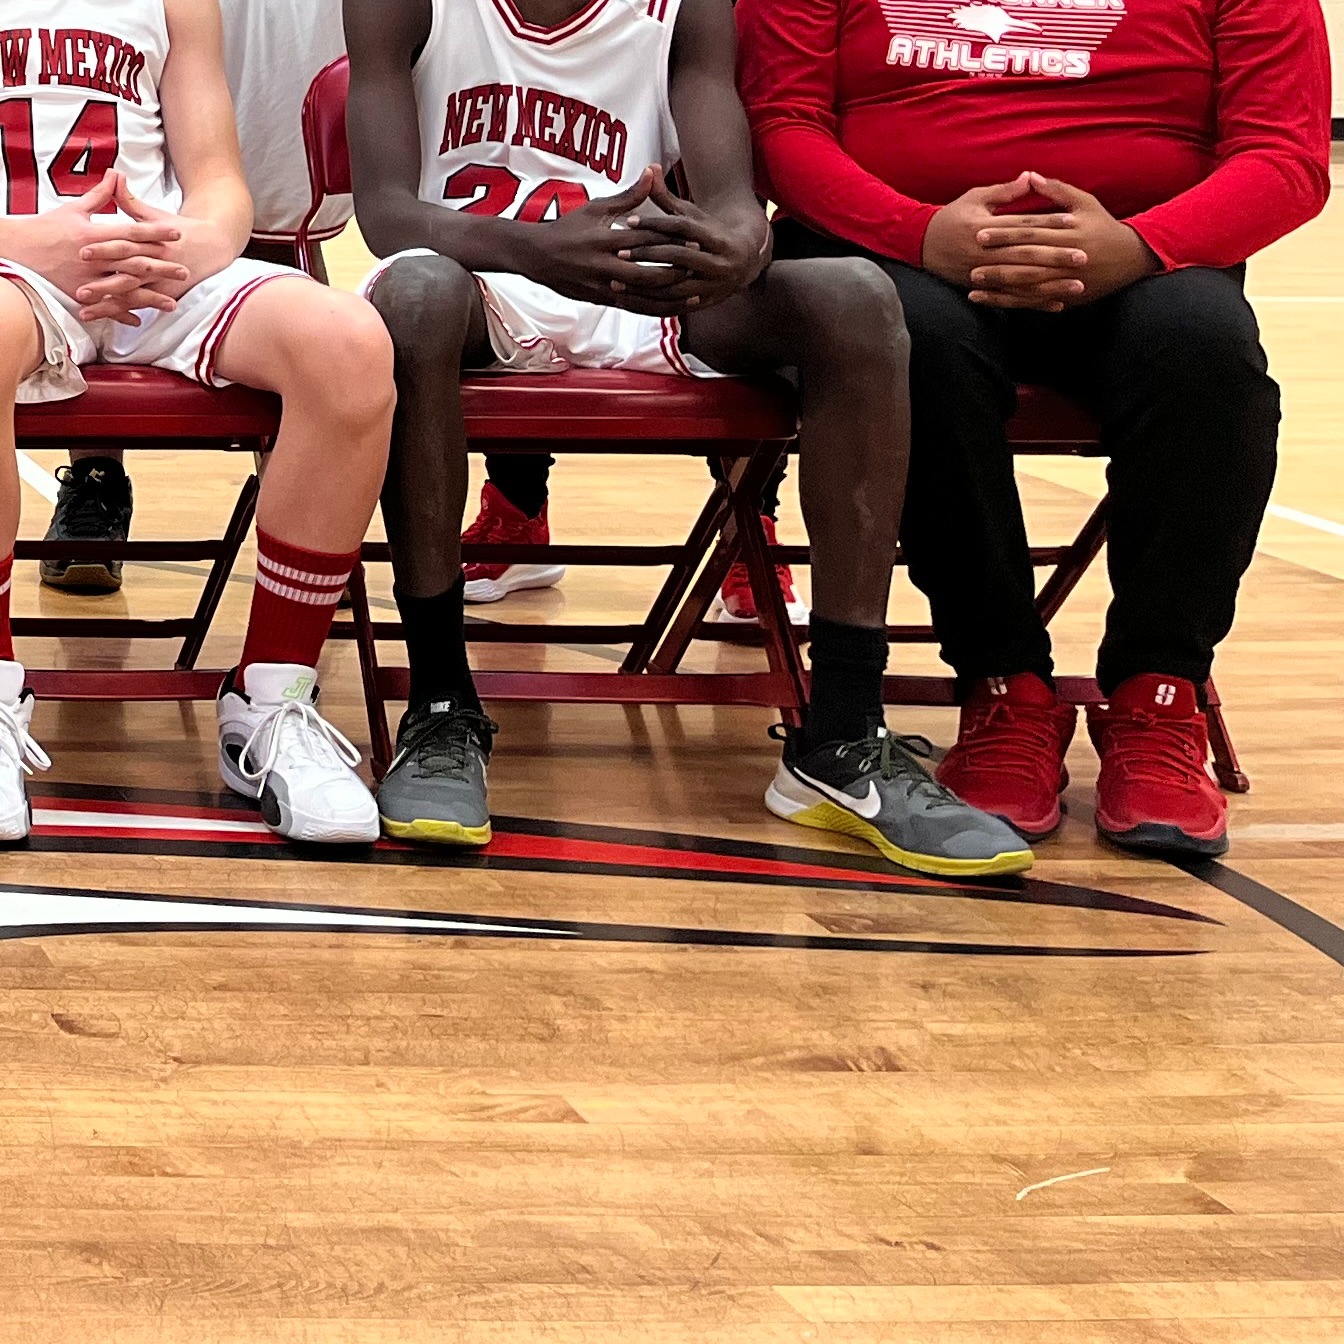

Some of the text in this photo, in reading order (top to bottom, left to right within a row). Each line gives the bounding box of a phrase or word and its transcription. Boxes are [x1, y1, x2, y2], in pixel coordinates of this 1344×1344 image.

[38, 28, 145, 106] MEXICO
[886, 34, 1091, 78] ATHLETICS
[439, 83, 627, 184] NEW MEXICO
